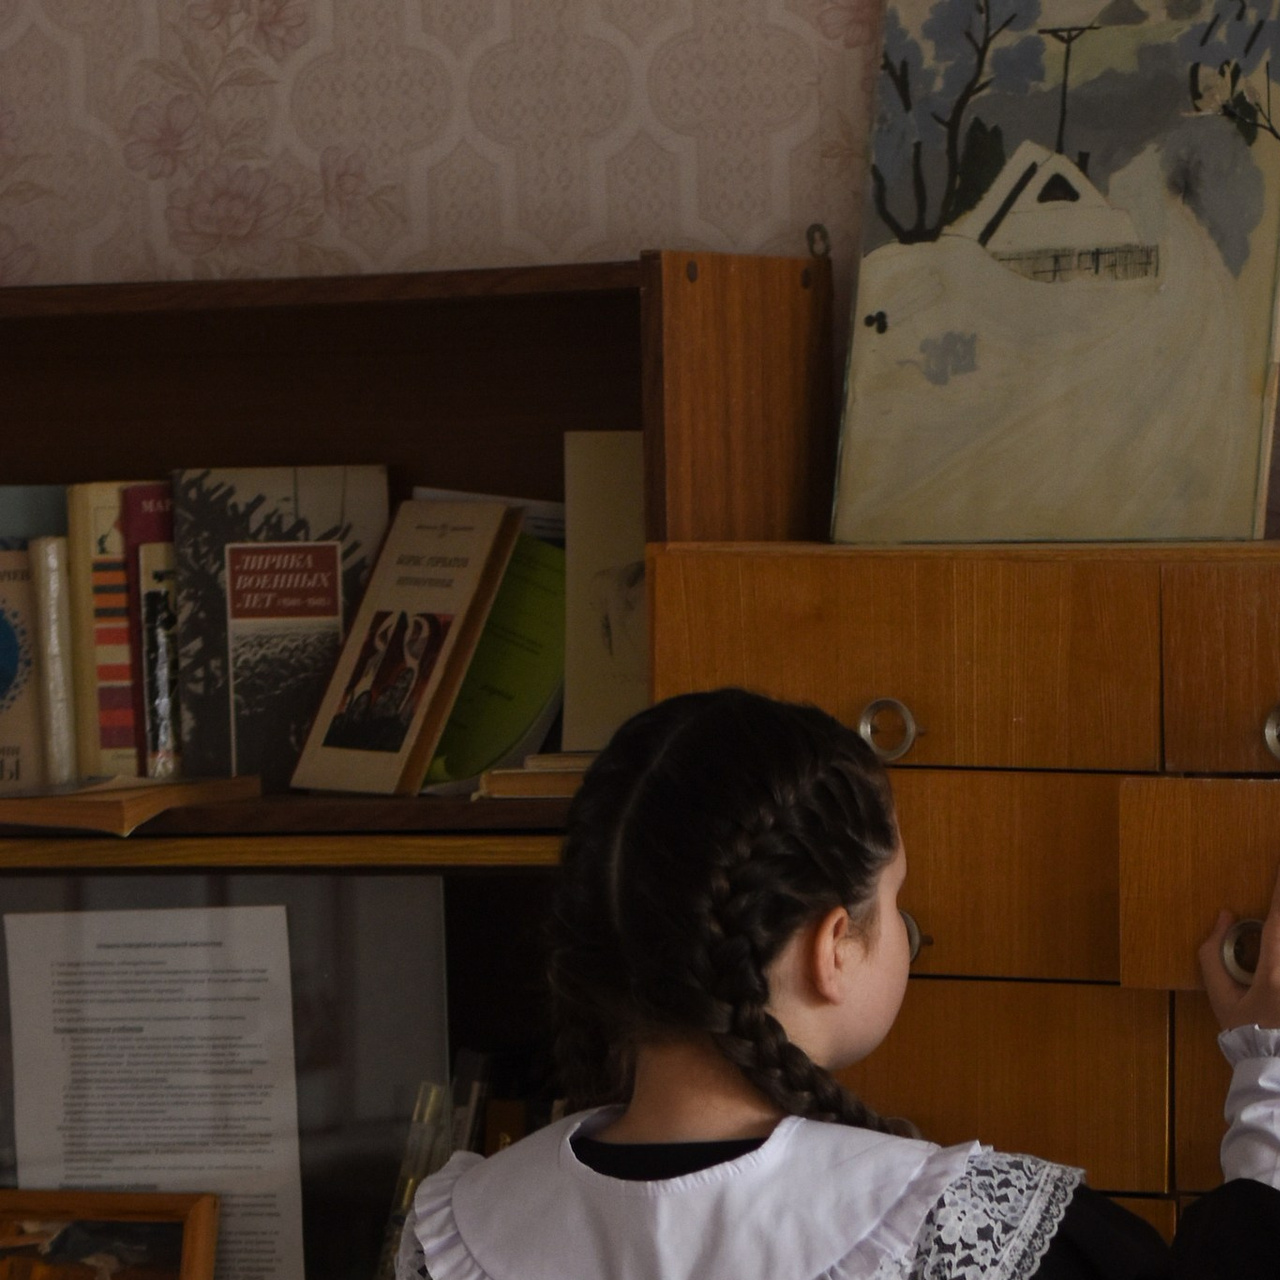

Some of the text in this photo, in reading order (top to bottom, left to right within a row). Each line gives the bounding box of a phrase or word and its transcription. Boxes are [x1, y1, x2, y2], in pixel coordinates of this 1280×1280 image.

[235, 553, 314, 571] ЛИРИКА
[235, 571, 332, 591] ВОЕННЫХ
[235, 592, 277, 609] ЛЕТ
